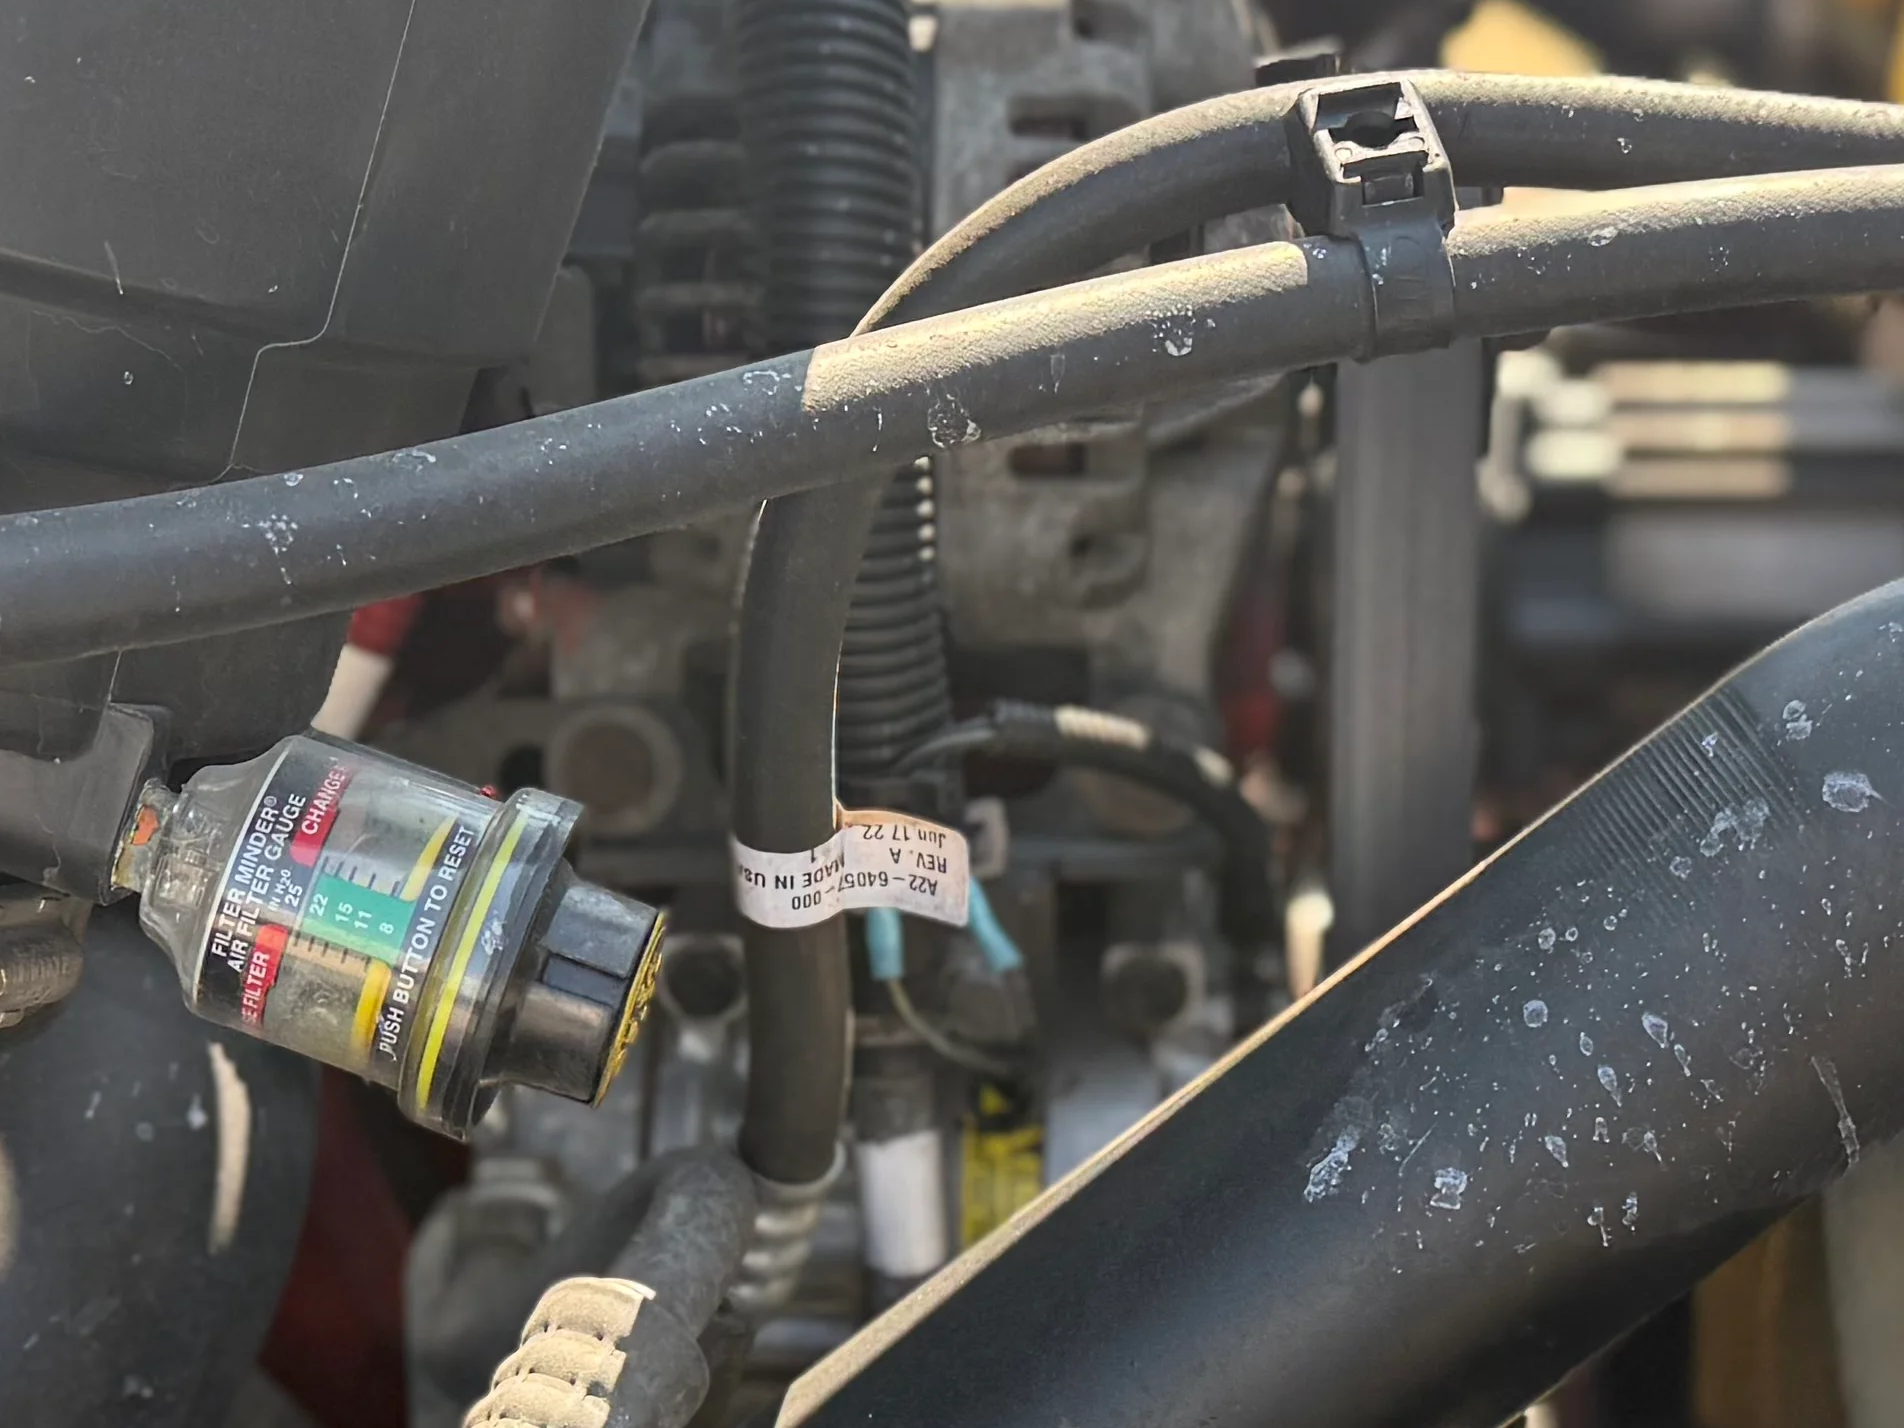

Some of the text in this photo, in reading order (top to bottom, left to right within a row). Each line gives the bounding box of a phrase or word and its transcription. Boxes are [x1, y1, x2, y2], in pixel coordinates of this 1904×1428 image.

[863, 824, 946, 848] Jun 17 22
[889, 847, 902, 864] A
[775, 874, 795, 890] IN
[802, 852, 845, 888] MADE
[227, 793, 306, 972] AIR FILTER GAUGE
[791, 871, 938, 910] A22-64057-000
[285, 883, 303, 907] 25
[309, 893, 328, 916] 22
[212, 888, 246, 957] FILTER
[335, 902, 353, 923] 15
[354, 910, 372, 929] 11
[379, 922, 394, 934] 8
[379, 825, 475, 1055] PUSH BUTTON TO RESET
[243, 950, 271, 1006] FILTER
